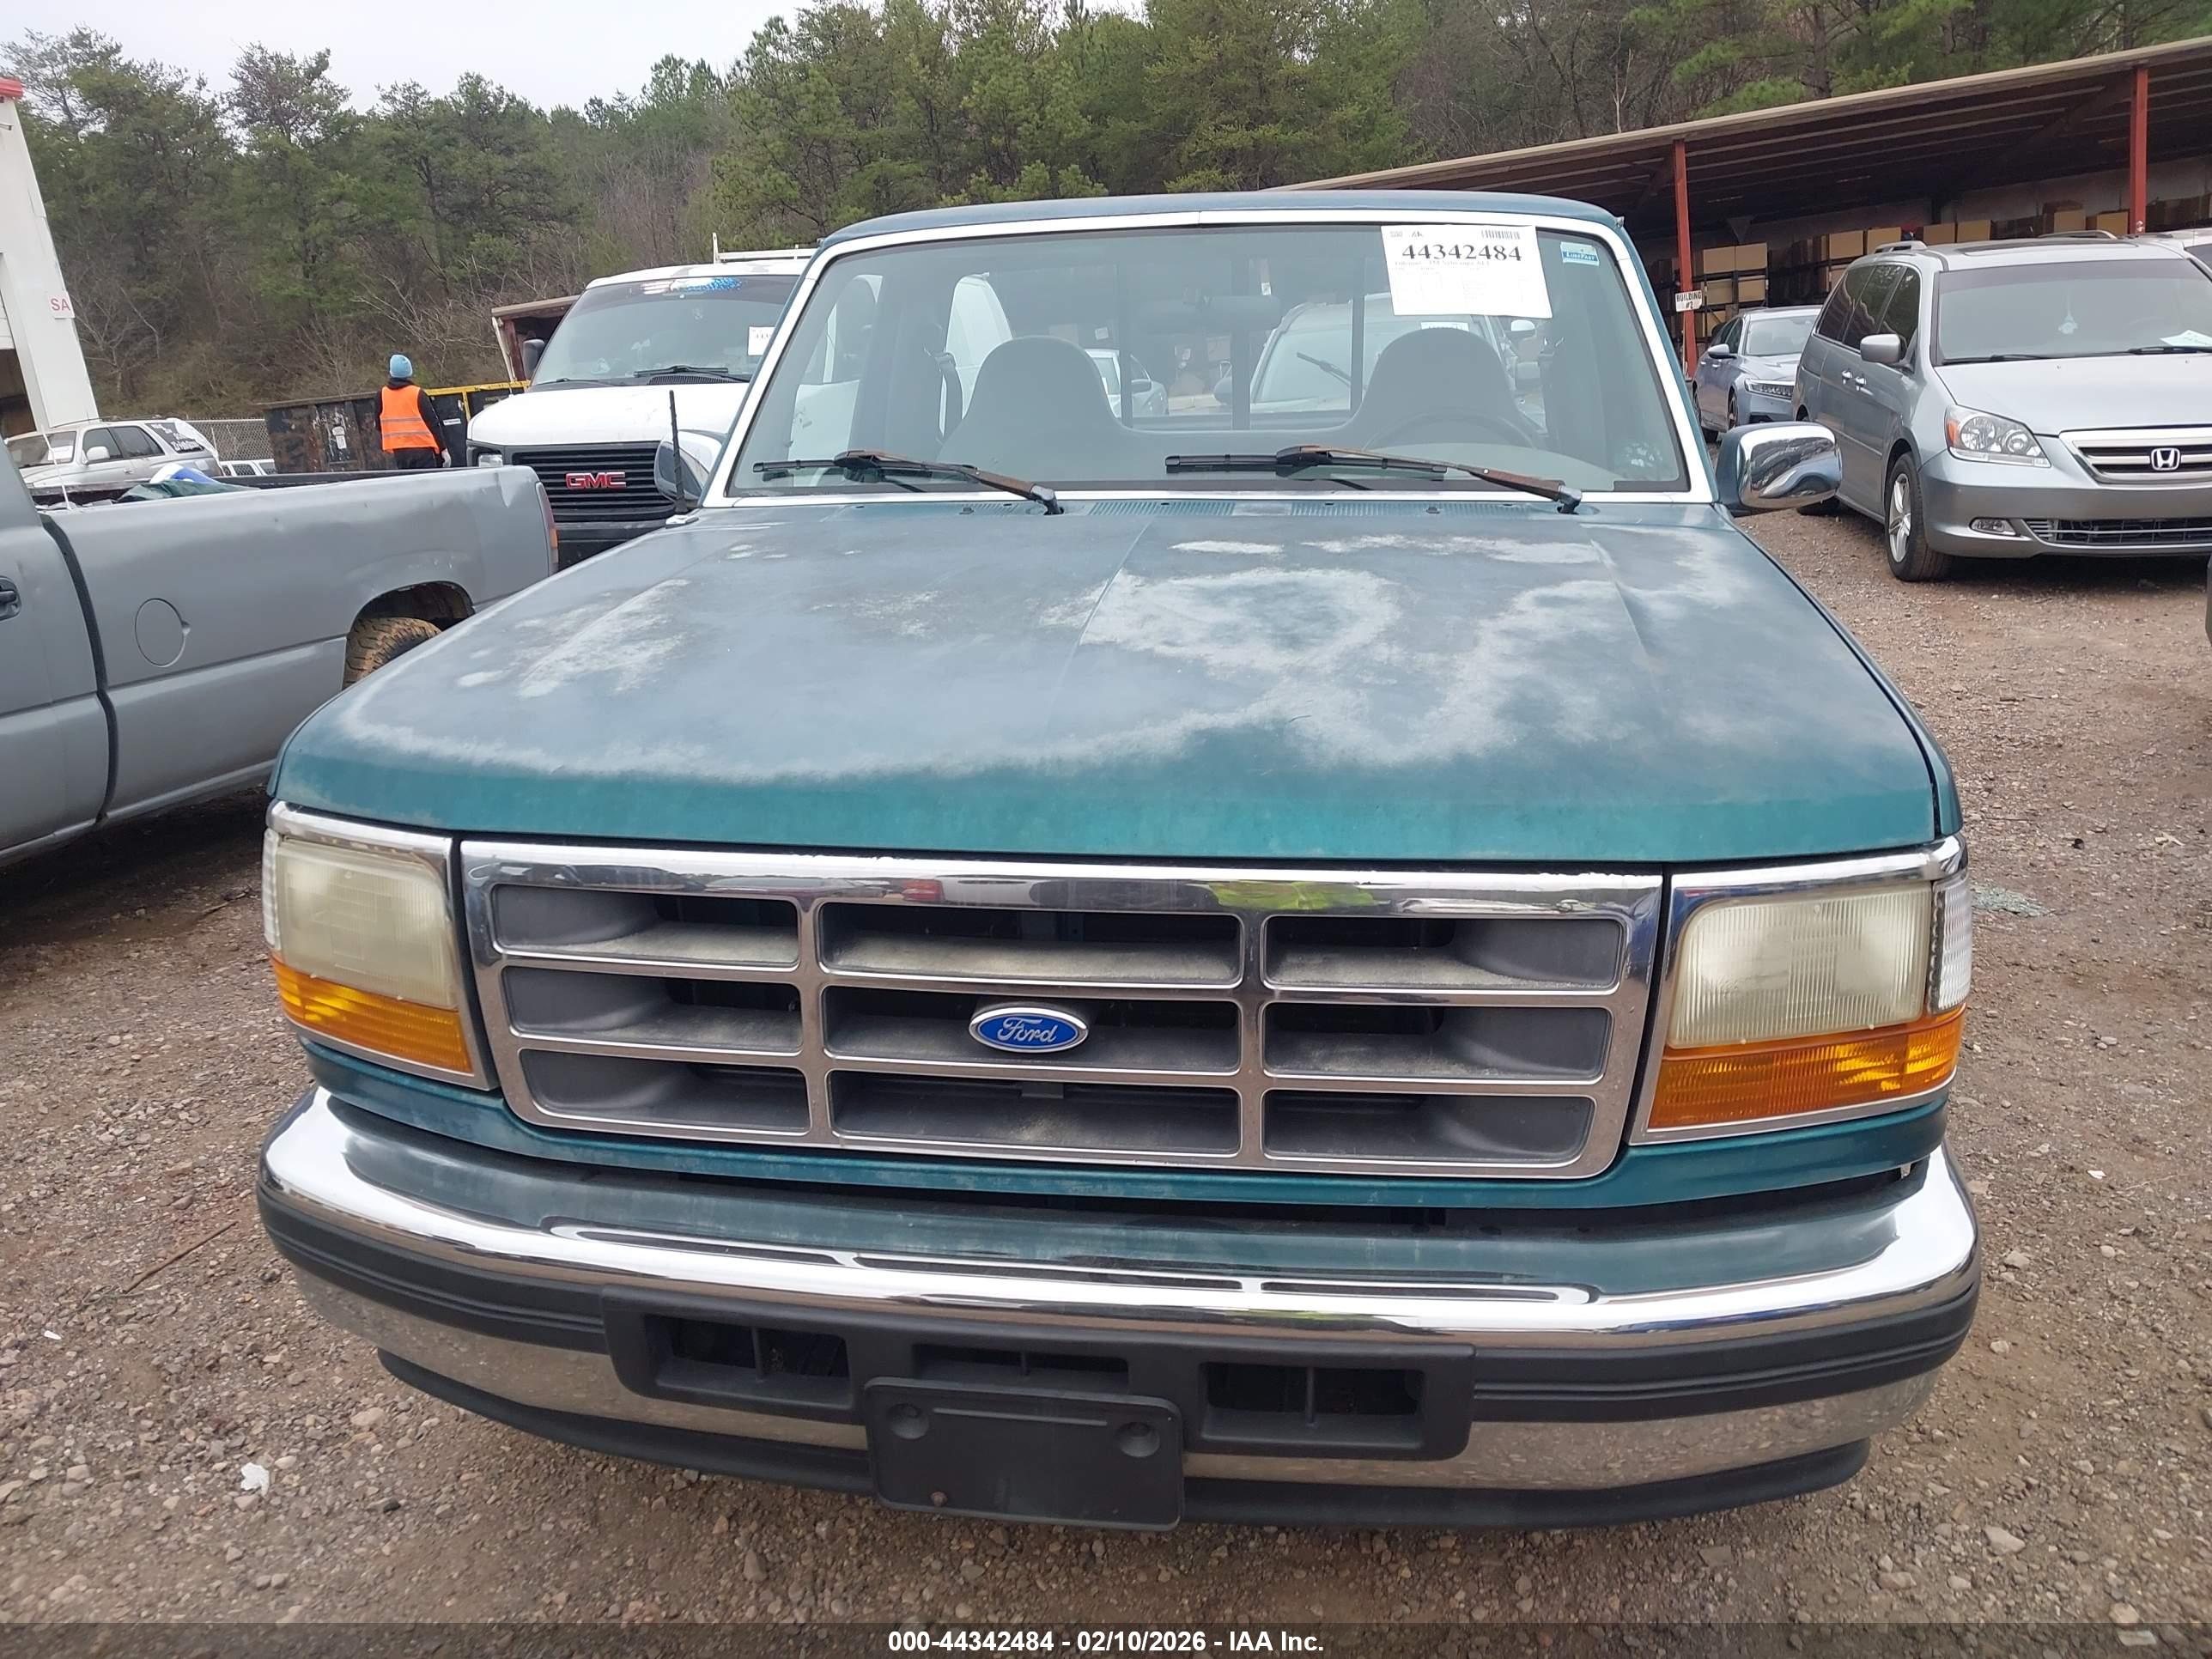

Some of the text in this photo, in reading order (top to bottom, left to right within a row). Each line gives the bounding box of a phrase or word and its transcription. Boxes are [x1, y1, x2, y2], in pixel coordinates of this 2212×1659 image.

[1401, 244, 1522, 261] 44342484
[1676, 291, 1701, 302] BUILDING
[566, 471, 627, 489] GMC
[997, 1017, 1058, 1042] Ford
